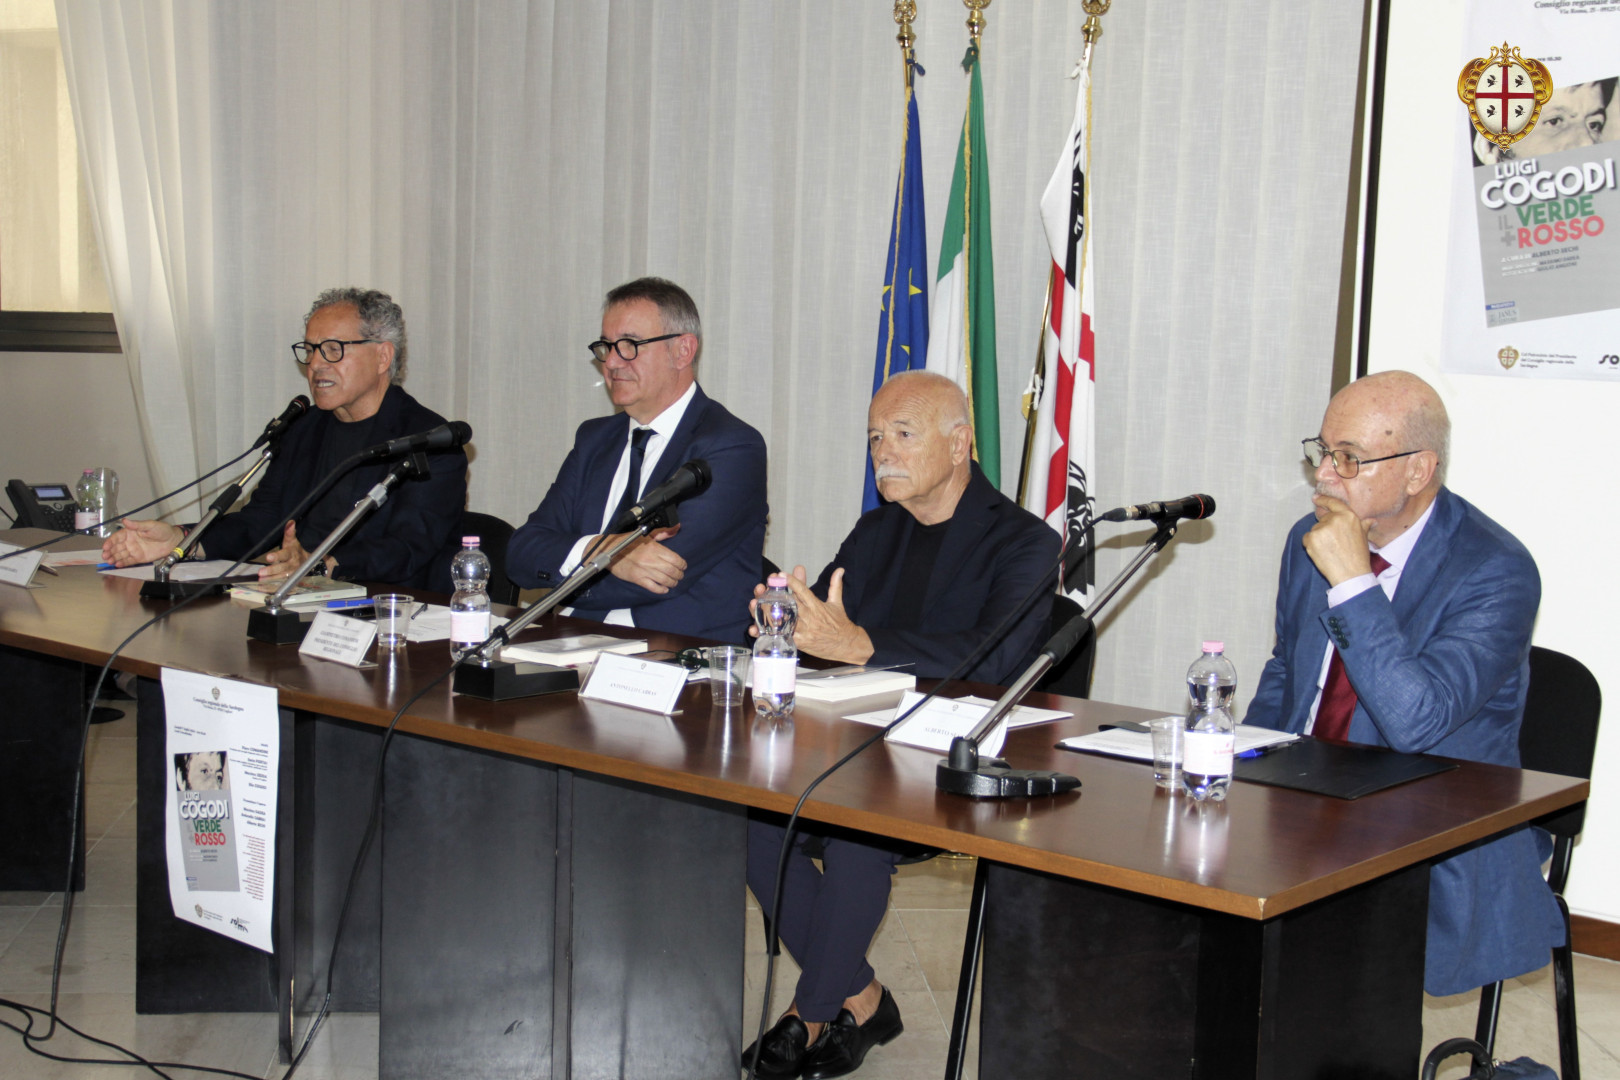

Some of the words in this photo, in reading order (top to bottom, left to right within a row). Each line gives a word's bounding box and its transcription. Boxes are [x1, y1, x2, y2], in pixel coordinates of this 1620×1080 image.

[1494, 158, 1538, 180] LUIGI
[1480, 158, 1616, 209] COGODI
[1498, 215, 1514, 231] IL
[1516, 195, 1595, 227] VERDE
[1517, 215, 1605, 249] ROSSO
[924, 727, 950, 736] ALBERTO
[184, 792, 200, 801] LUIGI
[180, 800, 229, 820] COGODI
[193, 819, 222, 833] VERDE
[194, 832, 226, 846] ROSSO
